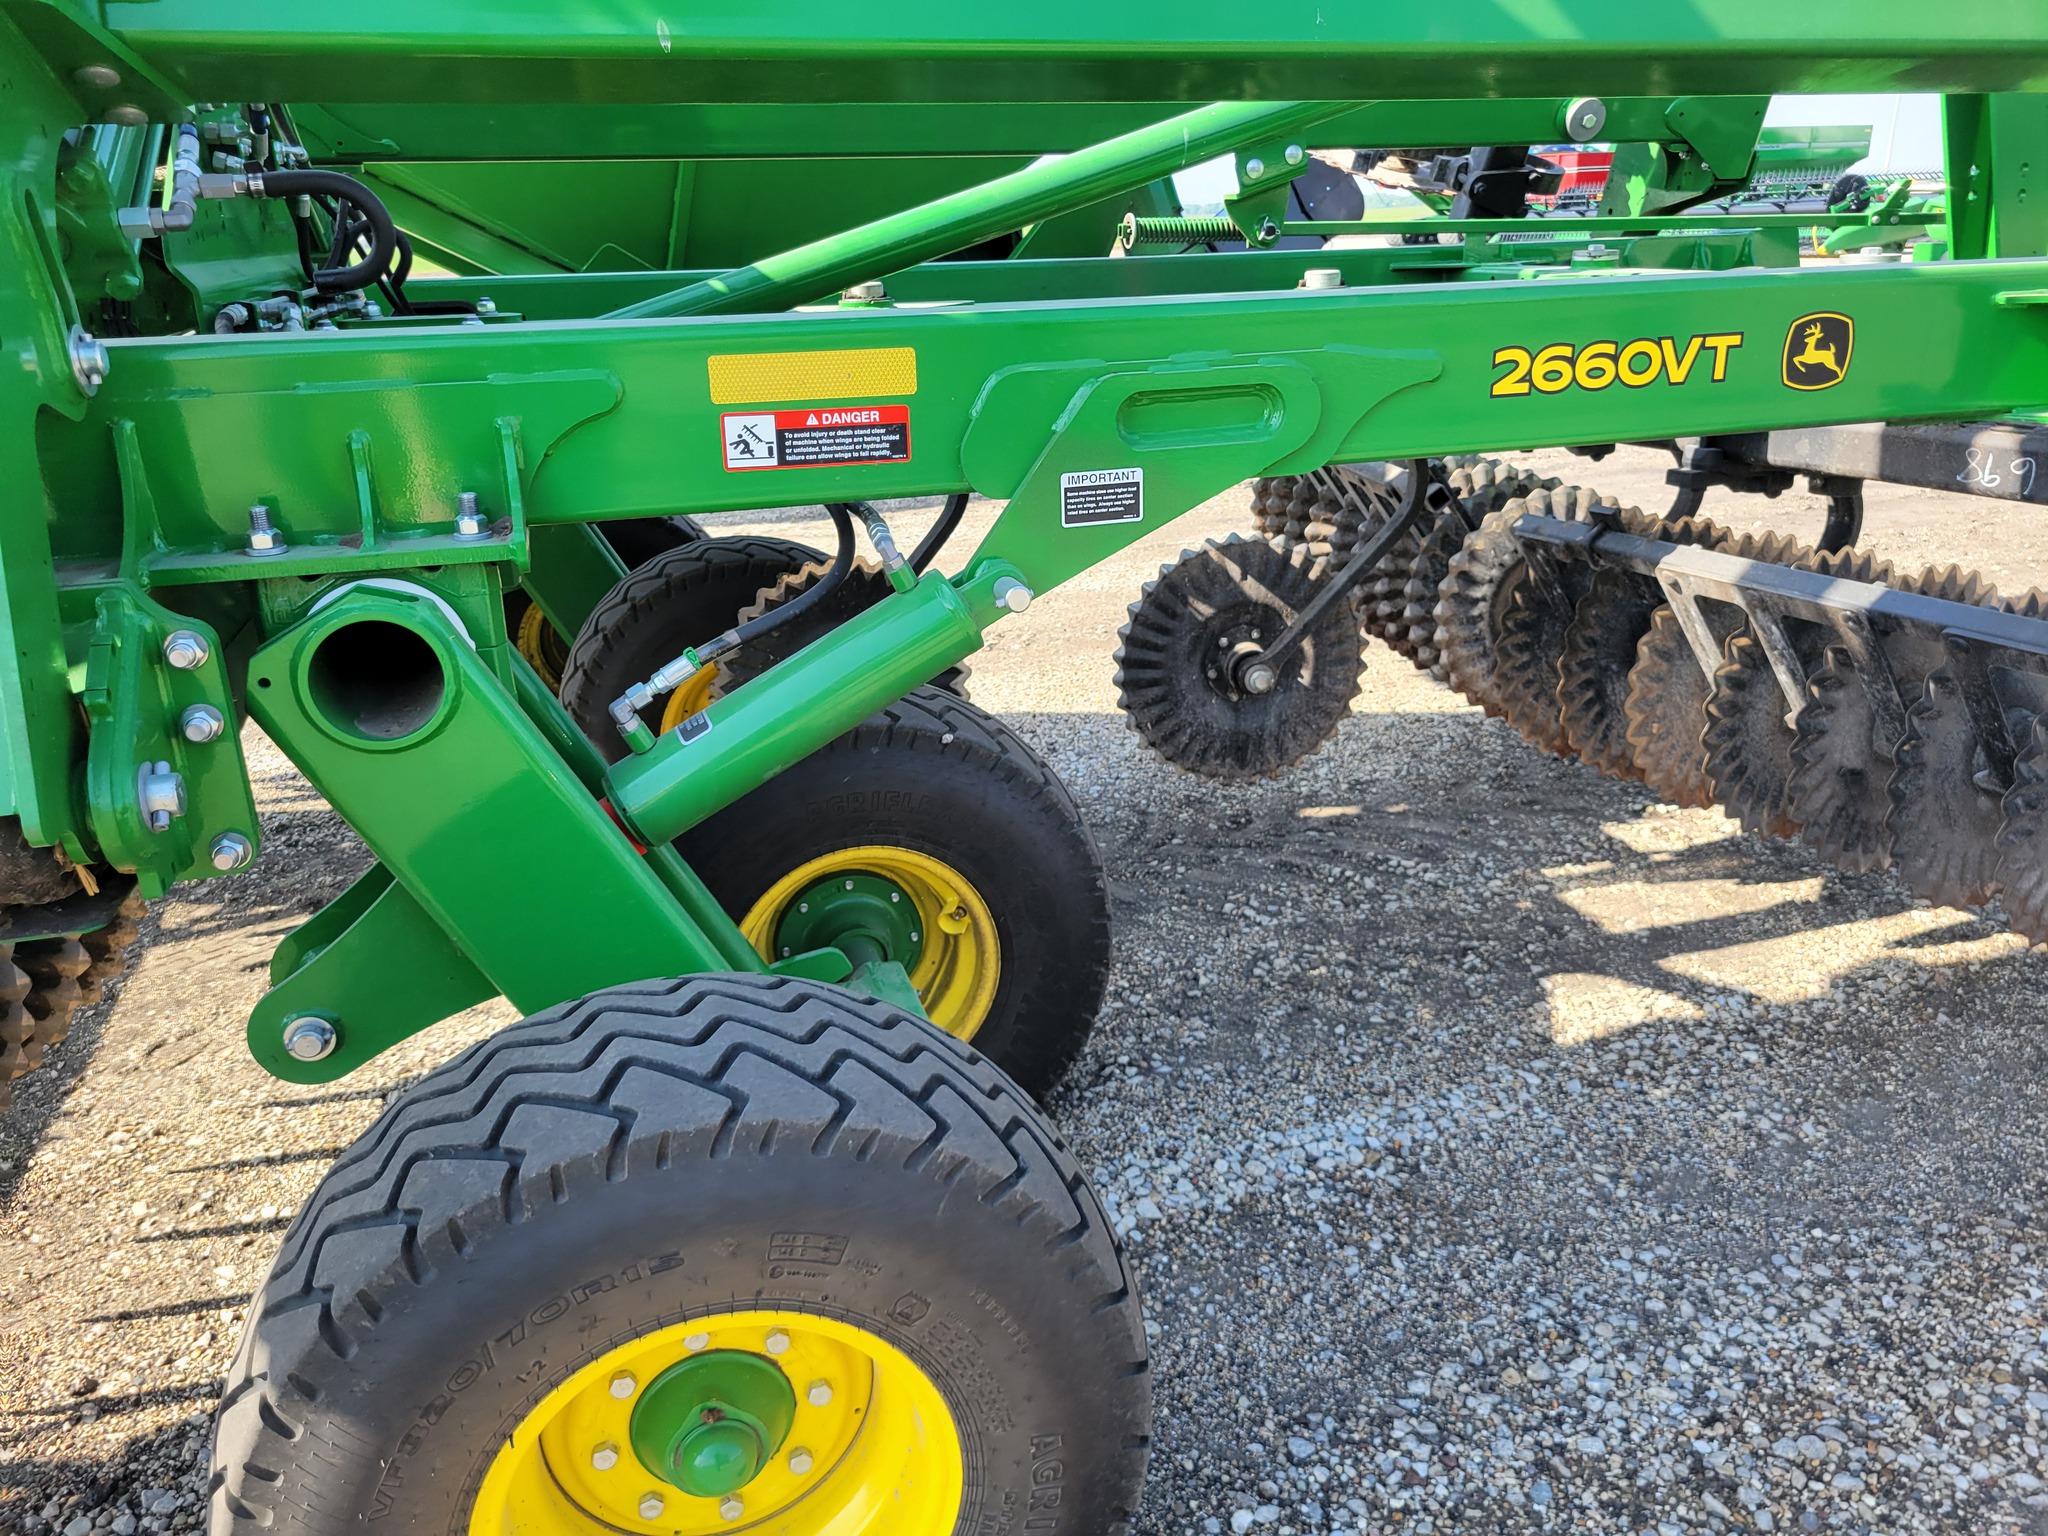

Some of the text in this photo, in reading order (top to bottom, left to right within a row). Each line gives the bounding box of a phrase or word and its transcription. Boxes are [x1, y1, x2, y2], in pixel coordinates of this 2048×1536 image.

[1490, 332, 1744, 398] 2660VT
[822, 411, 880, 425] DANGER
[821, 444, 854, 452] Mechanical
[863, 442, 890, 450] hydraulic
[834, 451, 851, 459] wings
[870, 449, 892, 457] rapidly.
[1068, 471, 1137, 486] IMPORTANT
